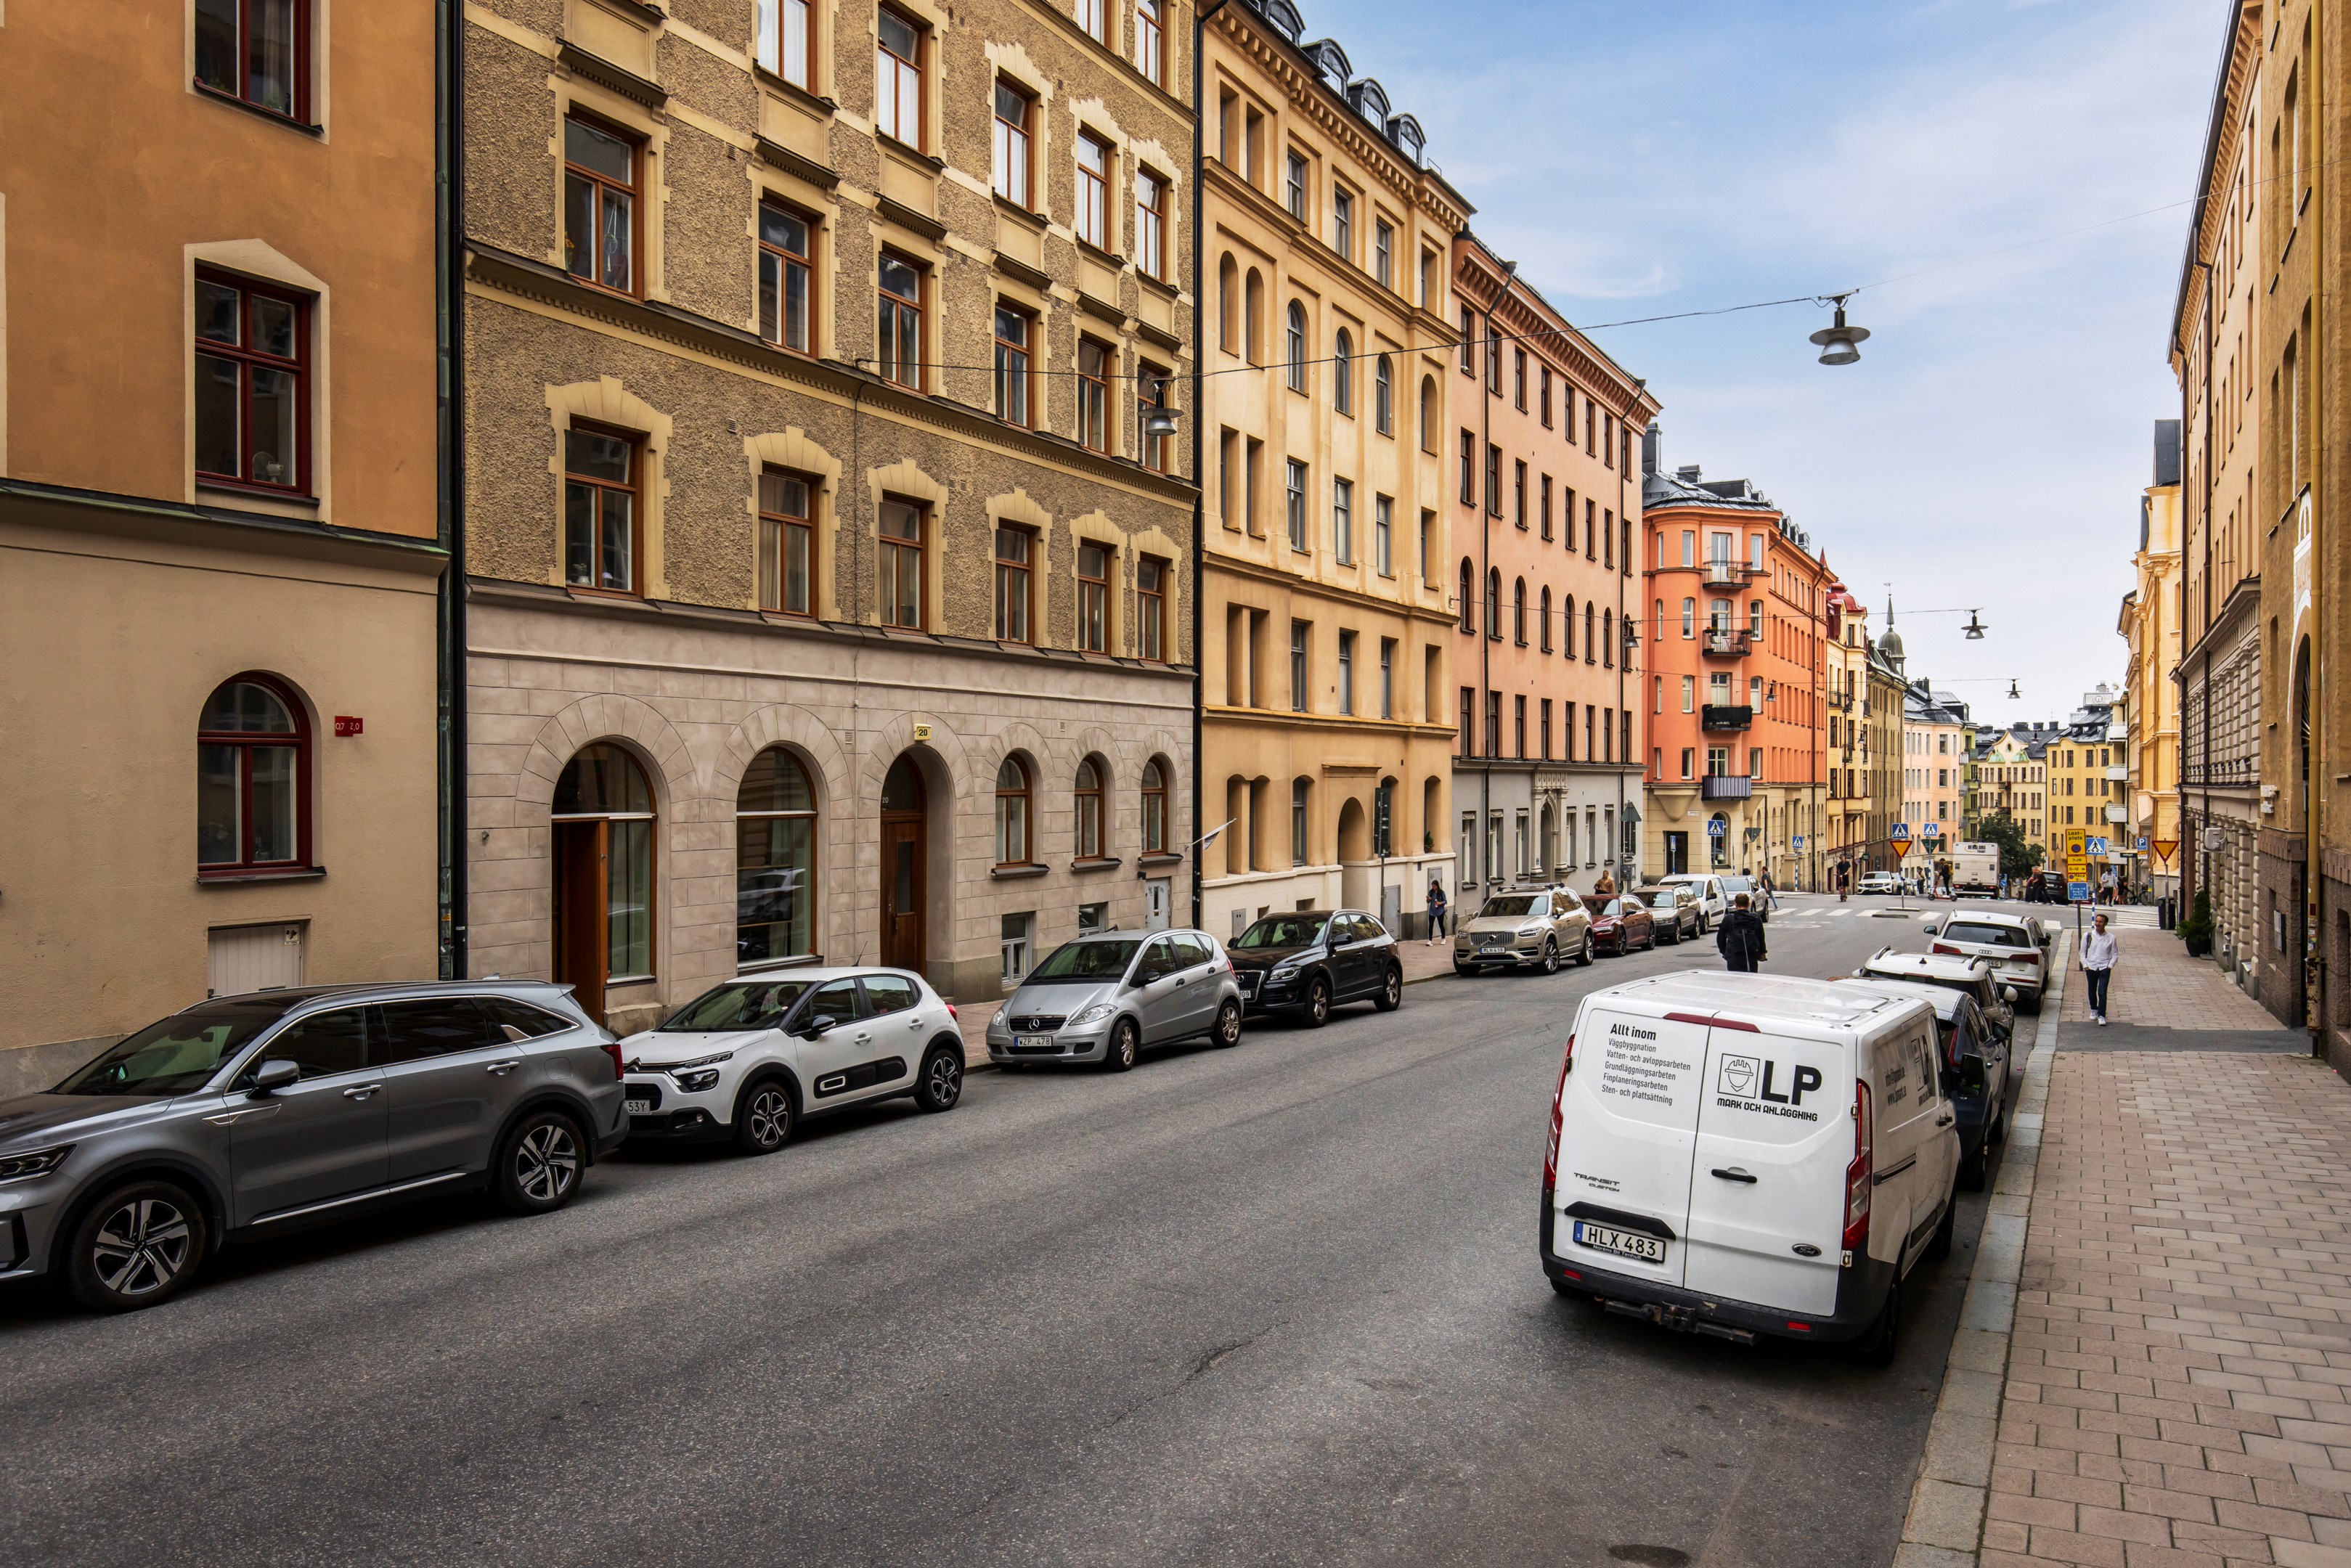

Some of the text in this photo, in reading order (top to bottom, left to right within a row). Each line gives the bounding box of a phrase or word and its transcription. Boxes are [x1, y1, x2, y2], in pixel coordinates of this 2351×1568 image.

[350, 722, 359, 731] 2,0
[1610, 1023, 1656, 1040] Allt inom
[1608, 1037, 1656, 1053] Väggbyggnation
[1607, 1050, 1628, 1060] Vatten-
[1642, 1056, 1691, 1071] avloppsarbeten
[1605, 1061, 1676, 1080] Grundläggningsarbeten
[1603, 1072, 1668, 1091] Finplaneringsarbeten
[1761, 1060, 1822, 1106] LP
[1602, 1085, 1673, 1106] Sten- och plattsättning
[629, 1101, 645, 1111] 53Y
[1717, 1098, 1818, 1122] MARK OCH ANLÄGGNING
[1573, 1172, 1620, 1186] TRANSIT
[1589, 1183, 1619, 1192] CUSTOM
[1588, 1227, 1655, 1256] HLX 483
[1593, 1244, 1612, 1253] Noréns
